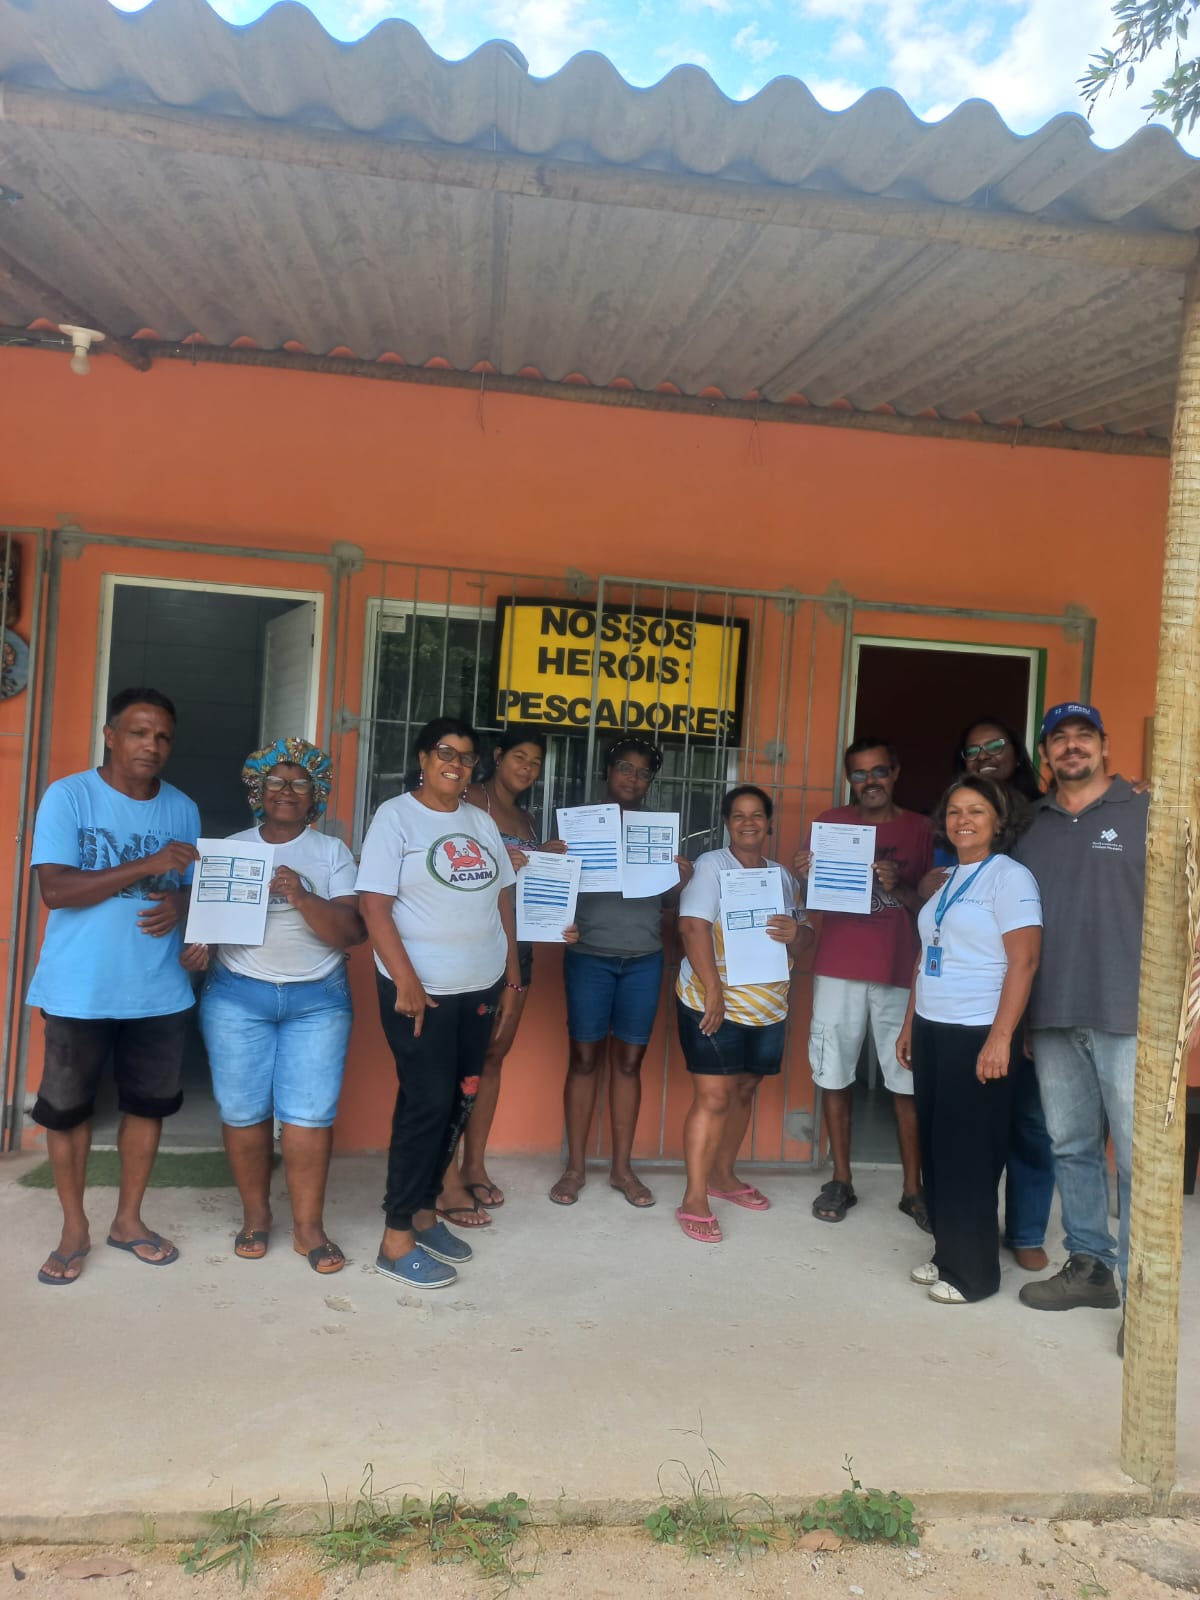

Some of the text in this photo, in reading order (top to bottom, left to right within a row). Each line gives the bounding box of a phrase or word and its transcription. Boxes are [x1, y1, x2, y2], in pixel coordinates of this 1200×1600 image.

[541, 607, 697, 650] NOSSOS
[538, 646, 693, 685] HERÓIS:
[497, 689, 737, 737] PESCADORES
[449, 871, 493, 882] ACAMM
